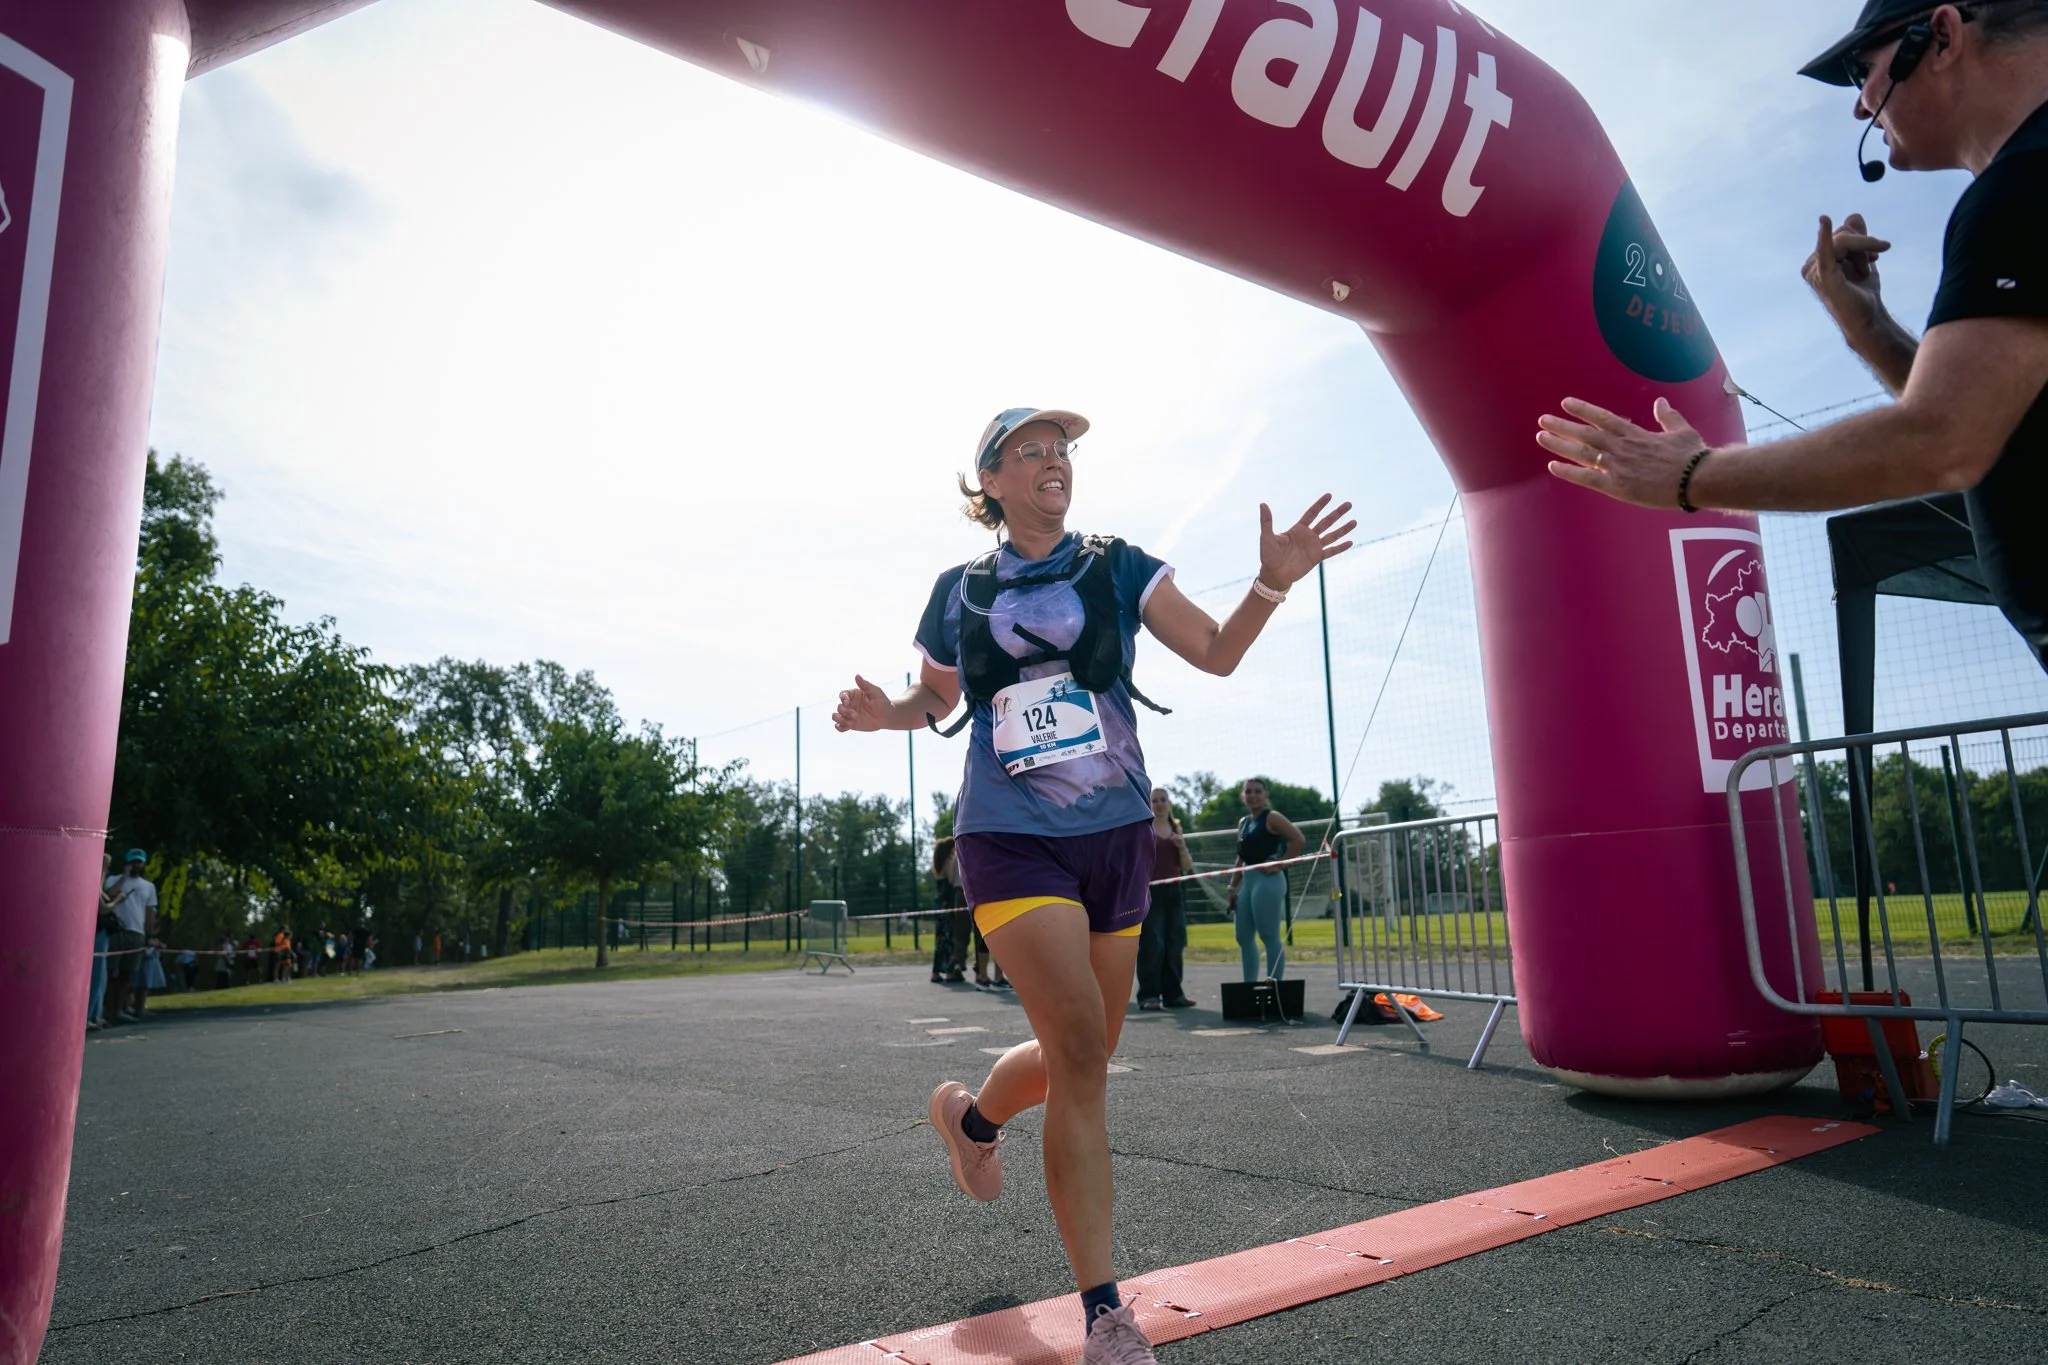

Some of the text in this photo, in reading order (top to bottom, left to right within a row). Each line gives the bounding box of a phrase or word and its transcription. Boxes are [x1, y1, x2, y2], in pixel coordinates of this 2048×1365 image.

[1626, 294, 1656, 327] DE
[1022, 704, 1057, 732] 124
[1031, 731, 1057, 744] VALERIE
